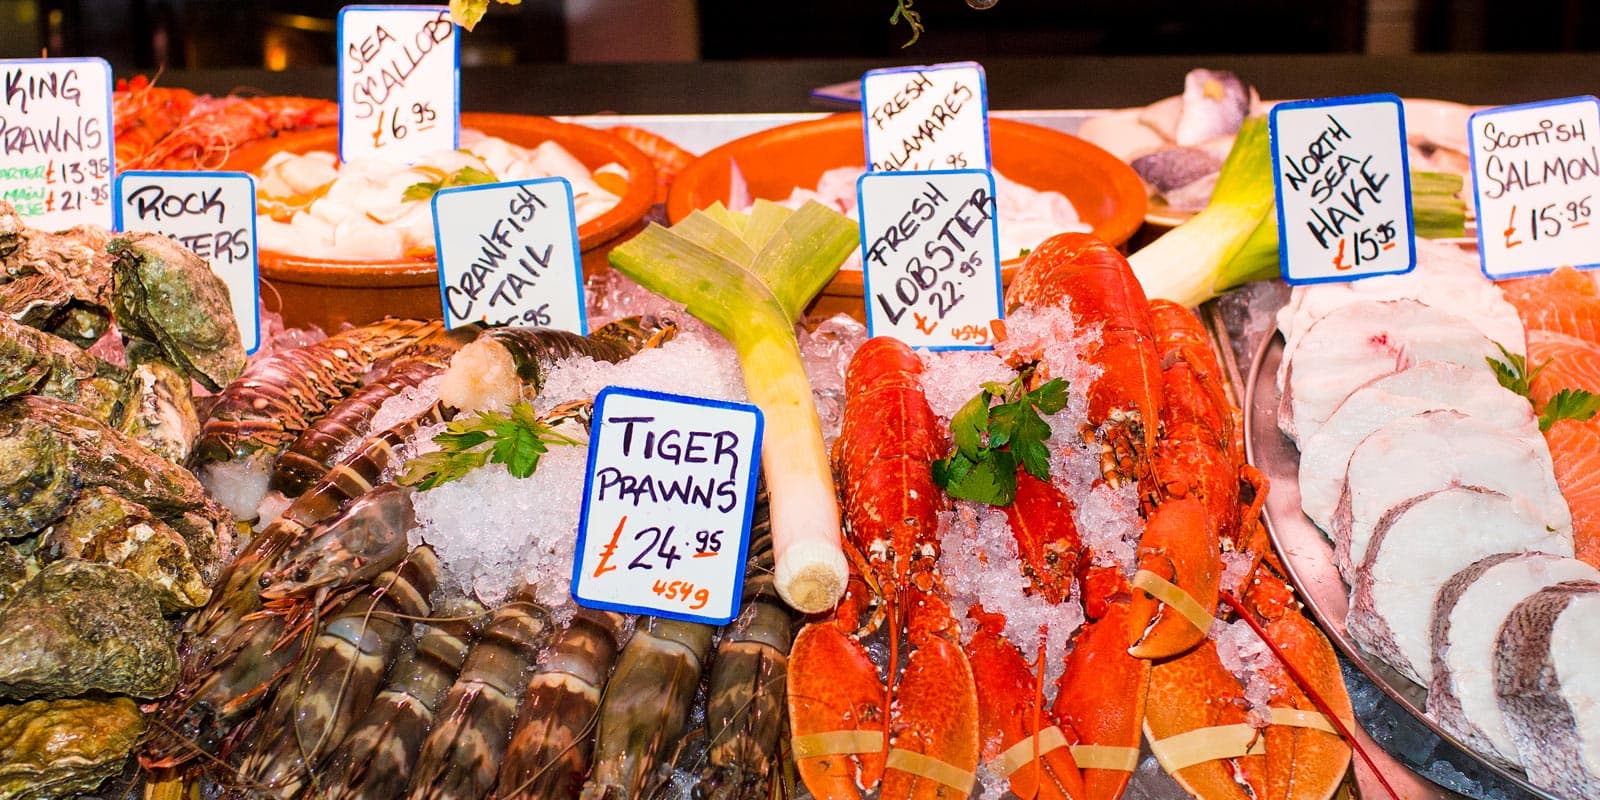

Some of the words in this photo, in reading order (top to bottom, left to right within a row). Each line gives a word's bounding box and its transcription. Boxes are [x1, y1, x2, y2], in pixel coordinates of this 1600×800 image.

[349, 25, 397, 74] SEA
[6, 68, 81, 114] KING
[871, 71, 934, 130] FRESH
[1285, 114, 1352, 191] NORTH
[1311, 155, 1361, 204] SEA
[1485, 146, 1600, 200] SALMON
[127, 185, 226, 224] ROCK
[865, 182, 949, 267] FRESH
[1307, 155, 1390, 249] HAKE
[158, 228, 249, 264] TERS
[445, 184, 548, 320] CRAWFISH
[877, 188, 997, 326] LOBSTER
[489, 244, 553, 307] TAIL
[608, 417, 739, 480] TIGER
[597, 467, 737, 513] PRAWNS
[652, 579, 710, 609] 454g
